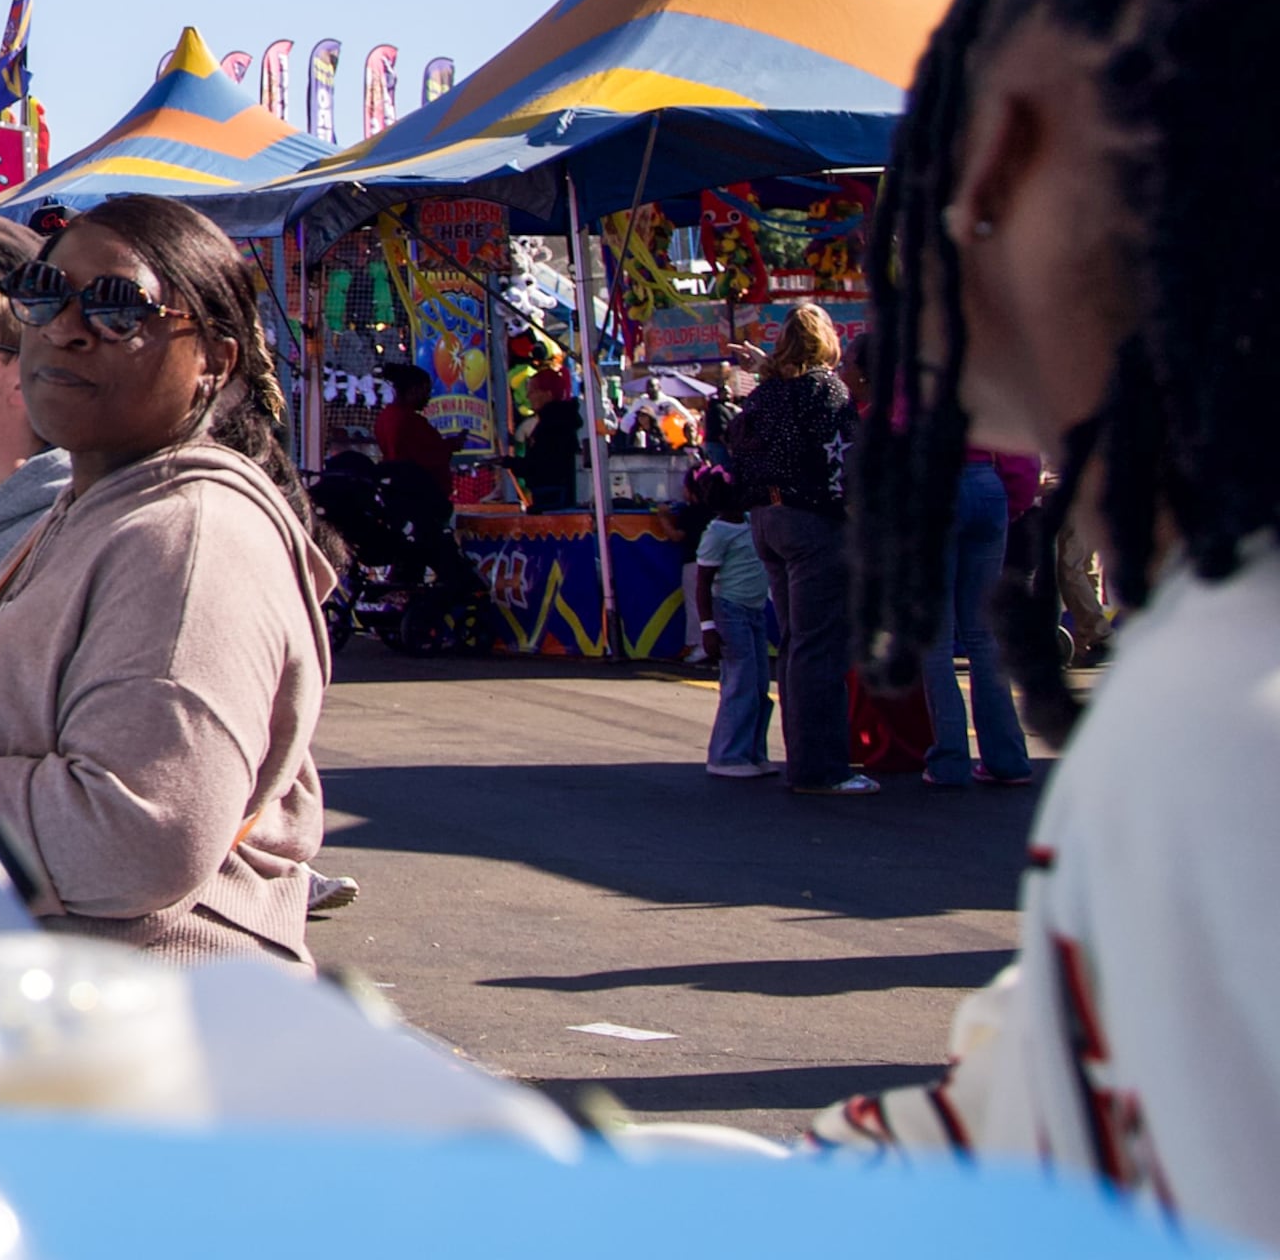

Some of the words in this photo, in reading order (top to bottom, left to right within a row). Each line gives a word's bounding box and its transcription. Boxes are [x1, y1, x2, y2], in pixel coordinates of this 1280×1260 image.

[421, 199, 502, 224] GOLDFISH
[441, 223, 484, 239] HERE
[653, 324, 719, 346] GOLDFISH
